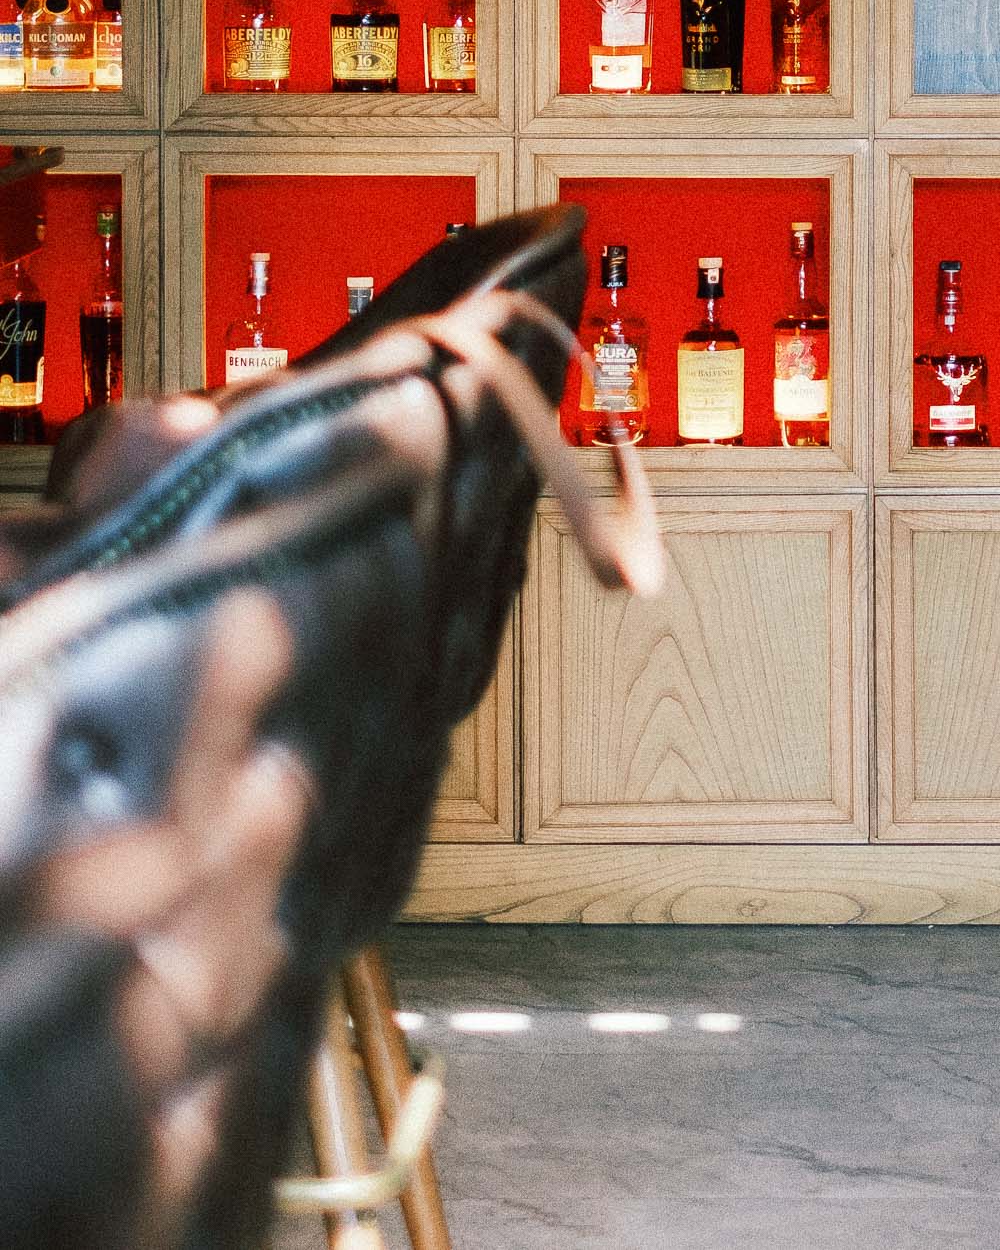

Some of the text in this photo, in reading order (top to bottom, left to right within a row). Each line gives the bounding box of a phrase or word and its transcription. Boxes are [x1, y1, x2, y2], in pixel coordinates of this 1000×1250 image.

[226, 28, 291, 41] ABERFELDY
[334, 26, 396, 39] ABERFELDY
[440, 33, 476, 43] ABERF
[251, 51, 265, 61] 12
[357, 54, 372, 67] 16
[461, 51, 474, 63] 21
[596, 348, 637, 359] JURA
[229, 356, 281, 367] BENRIACH
